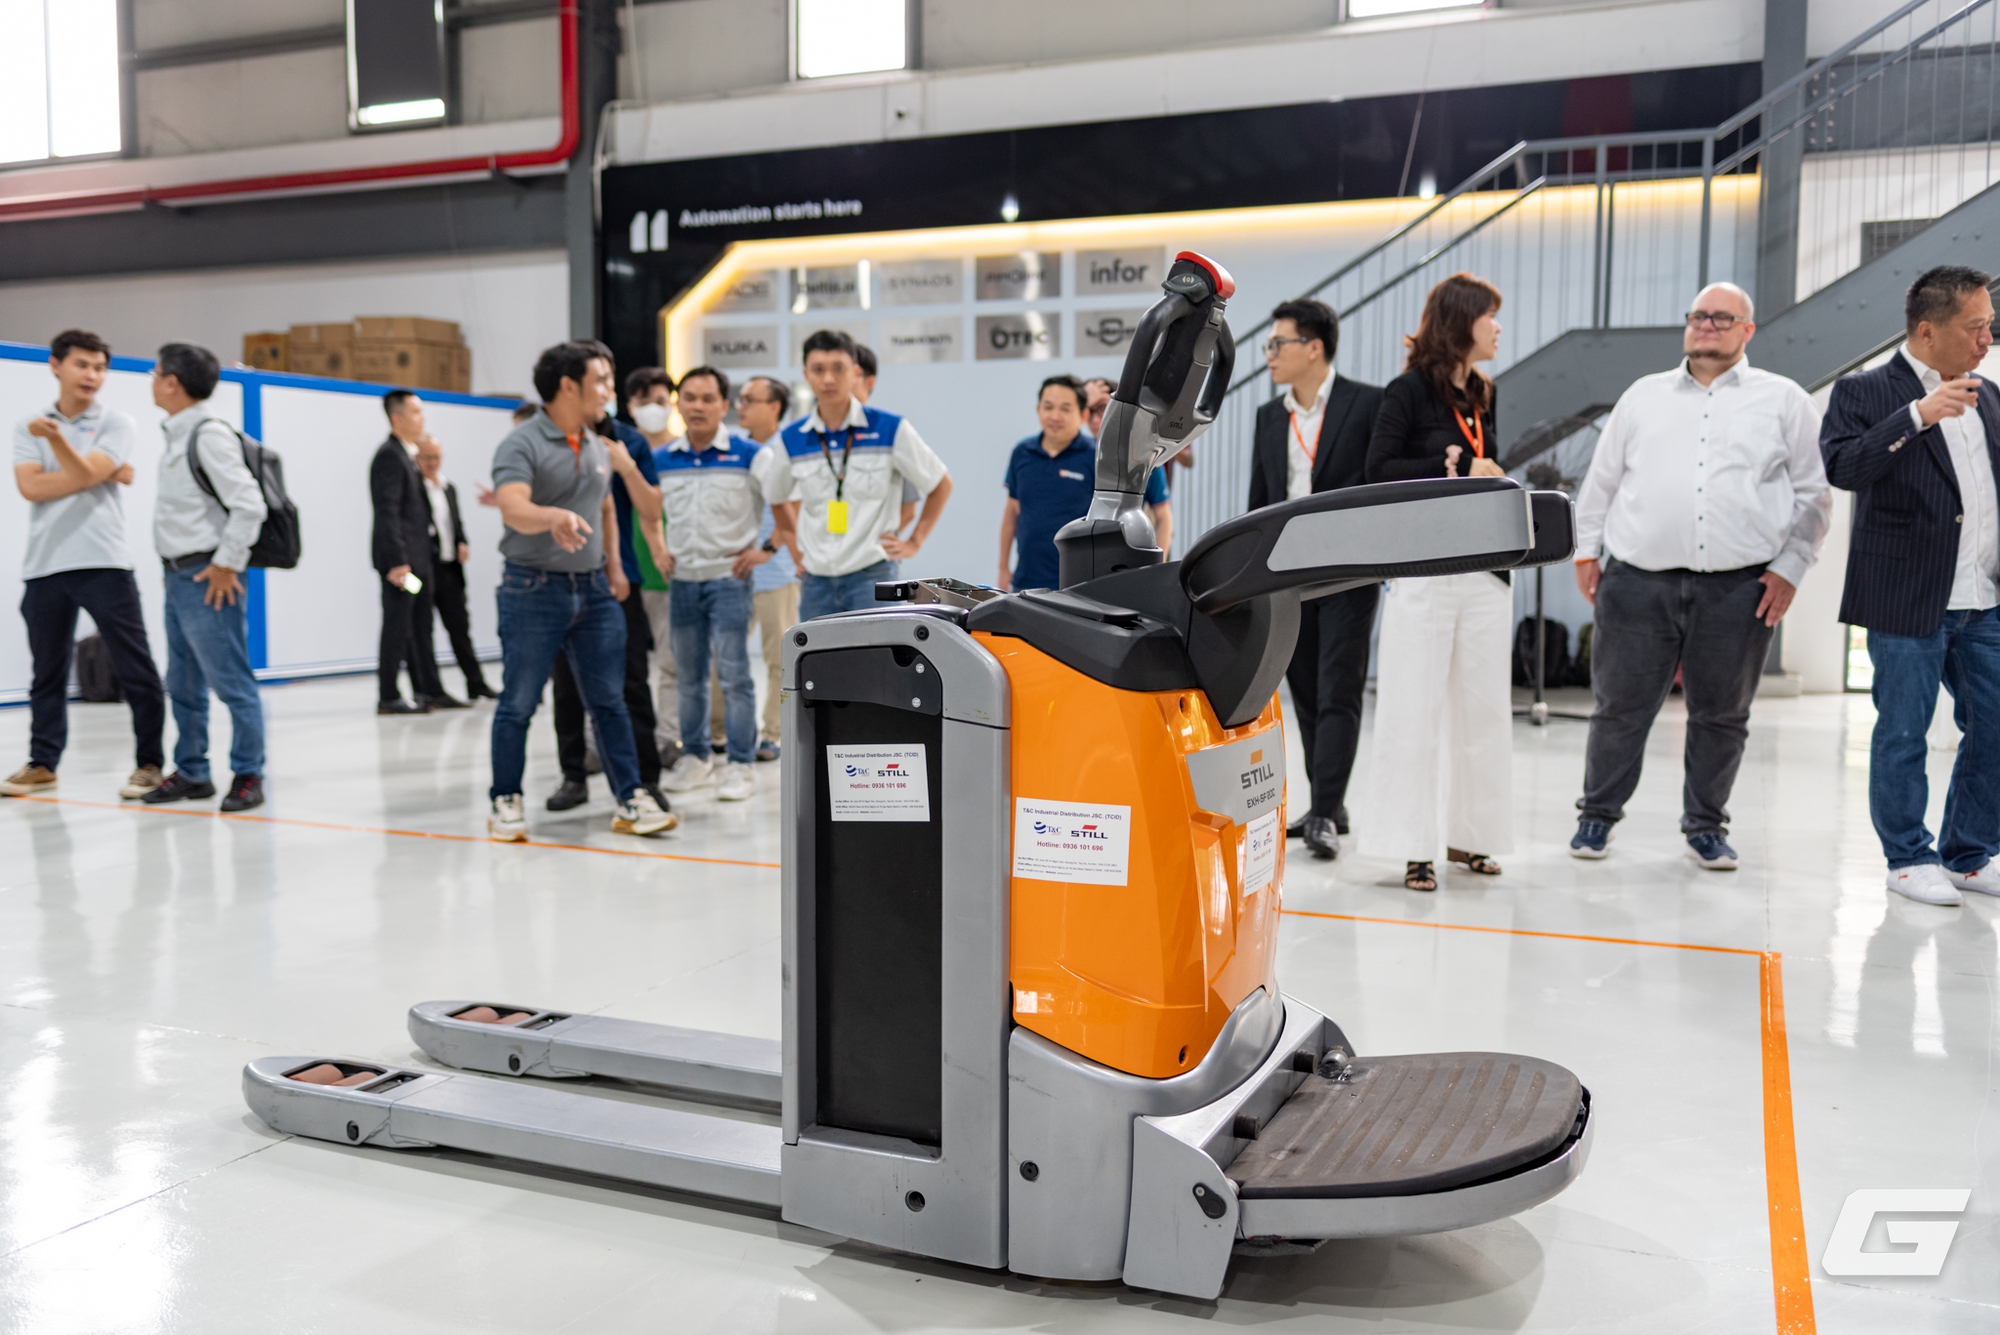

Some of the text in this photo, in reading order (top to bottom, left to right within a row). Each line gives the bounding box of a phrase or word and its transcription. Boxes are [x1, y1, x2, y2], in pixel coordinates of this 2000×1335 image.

[679, 198, 863, 228] Automation starts here
[1090, 258, 1147, 284] infor
[1241, 764, 1274, 790] STILL
[1060, 810, 1091, 818] Distribution
[1105, 813, 1122, 821] (TCID)
[1071, 830, 1108, 839] STILL
[1037, 841, 1061, 849] Hotline:
